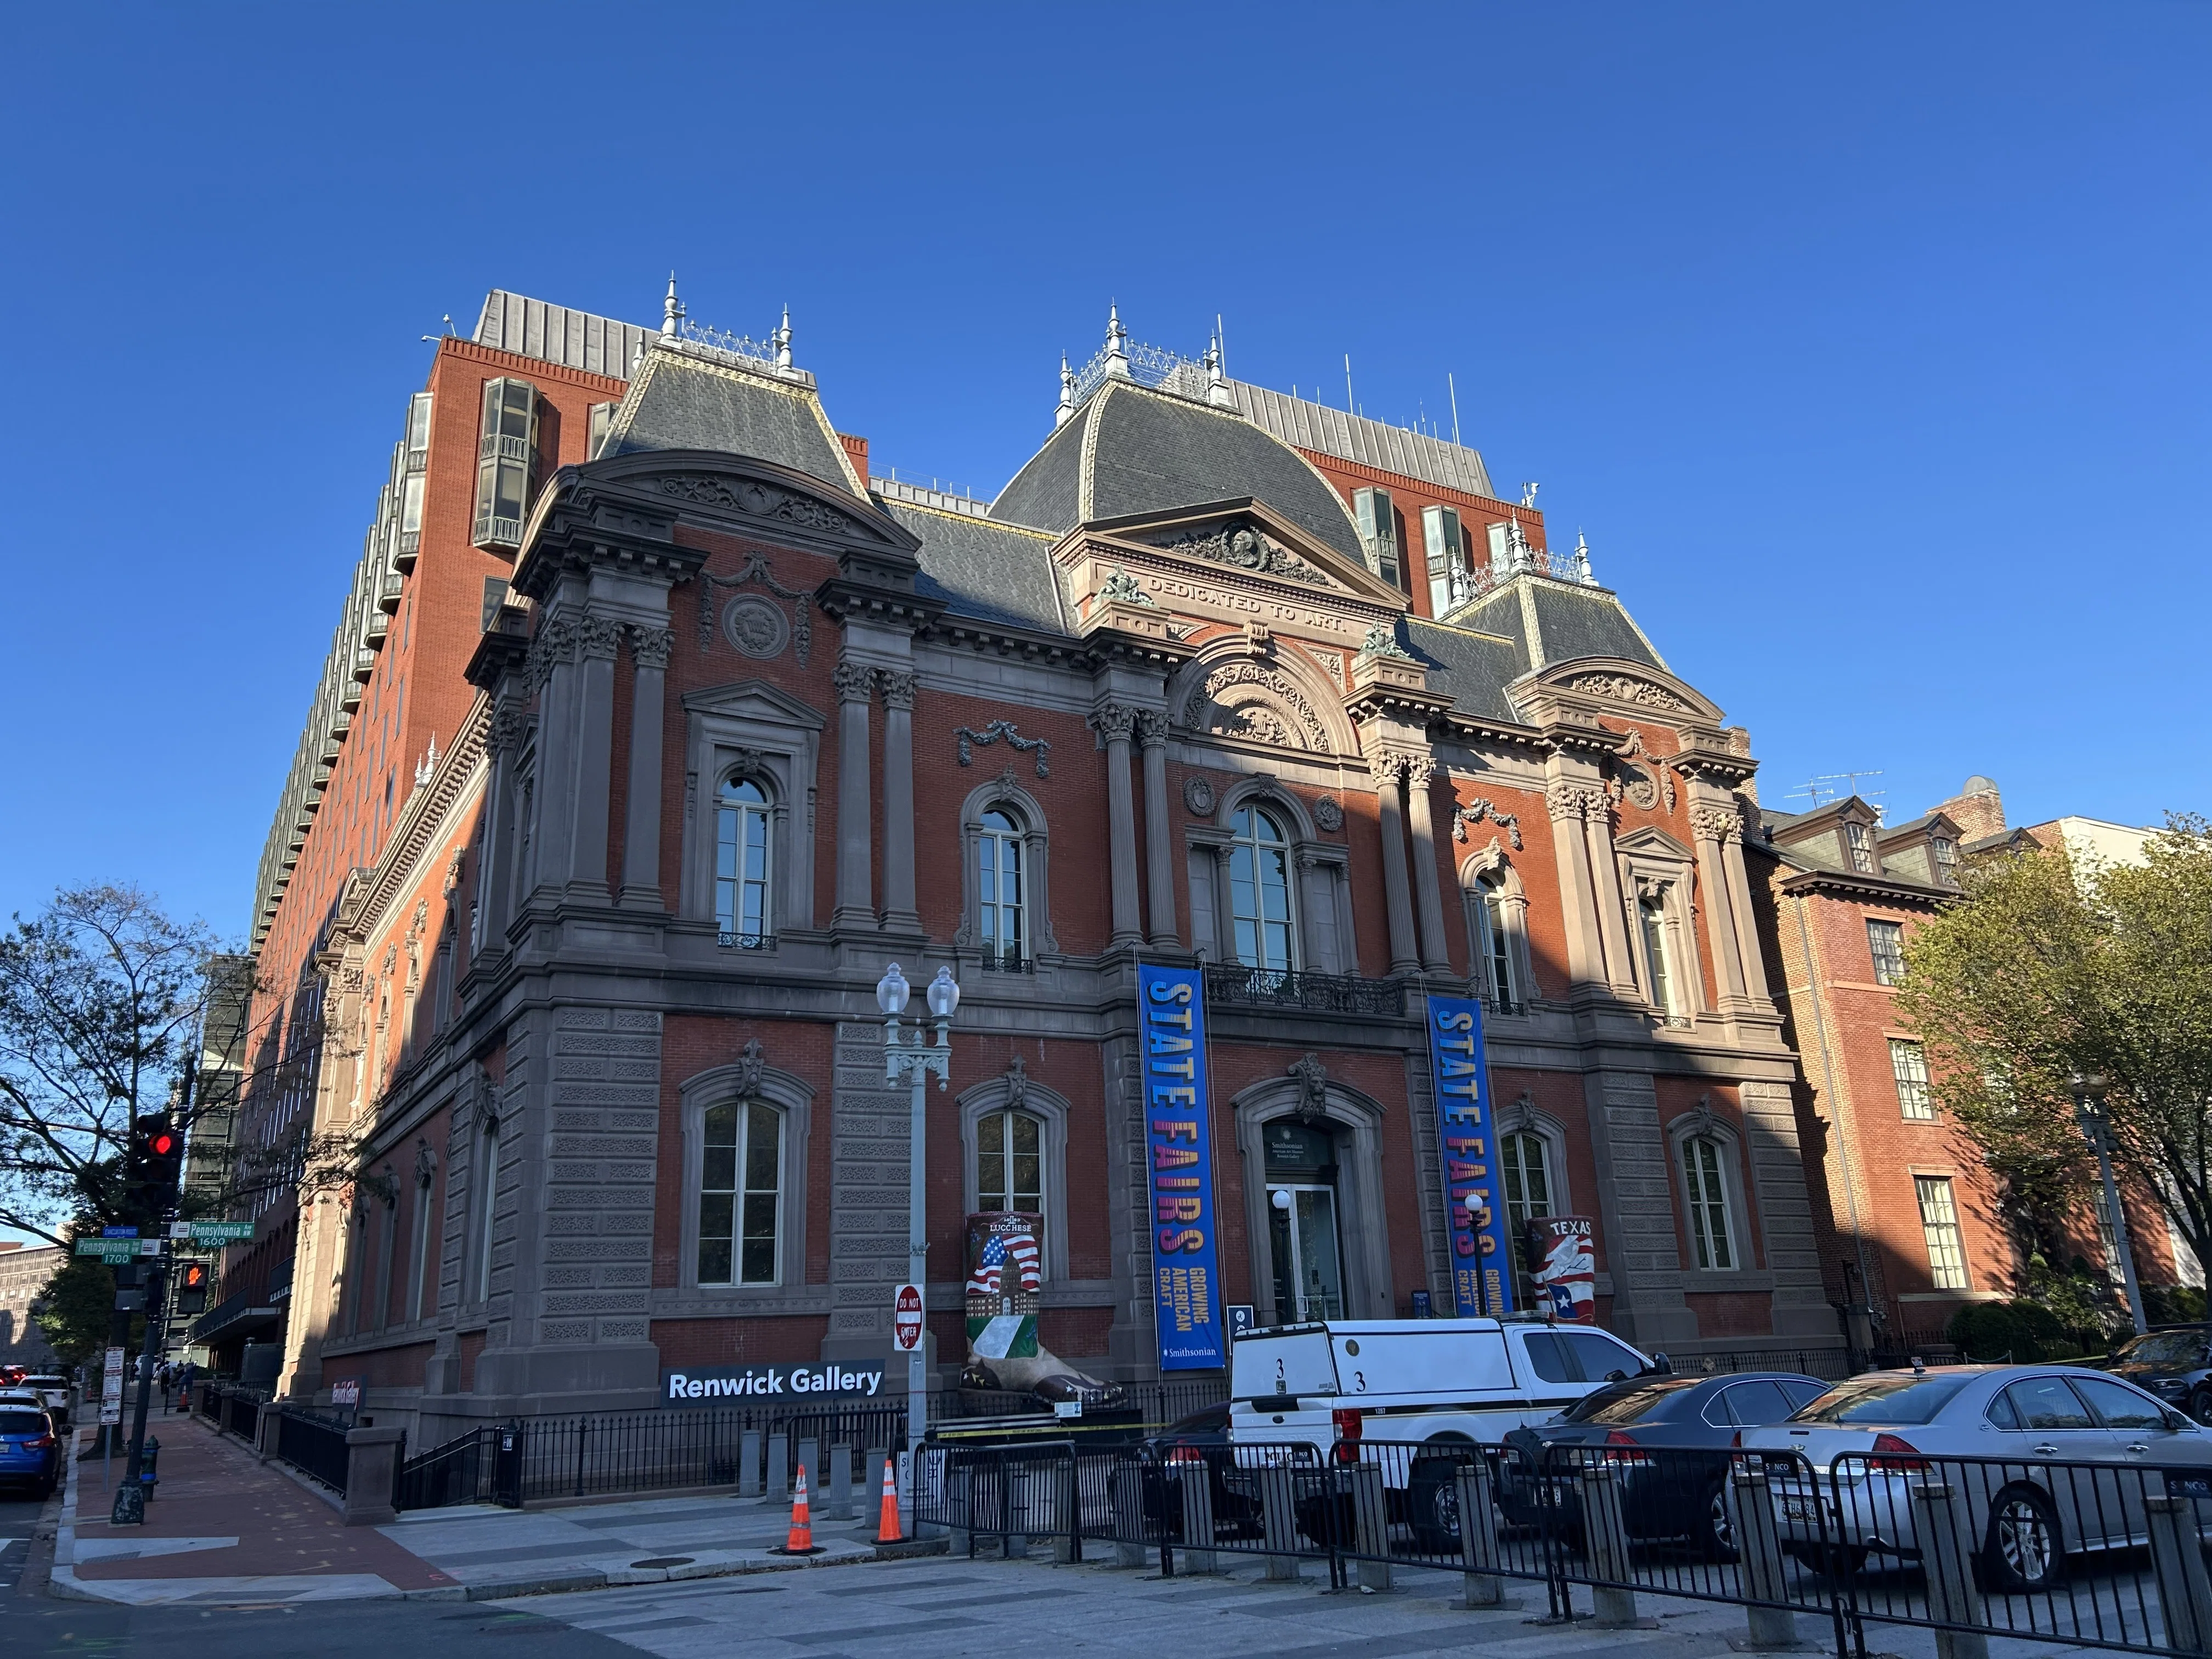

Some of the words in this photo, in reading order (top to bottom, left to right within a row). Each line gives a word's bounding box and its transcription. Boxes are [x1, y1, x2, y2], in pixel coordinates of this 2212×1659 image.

[1148, 576, 1261, 613] DEDICATED
[1269, 603, 1296, 620] TO
[1304, 611, 1346, 633] ART.
[1149, 980, 1197, 1107] STATE
[1437, 1010, 1482, 1124] STATE
[1272, 1141, 1303, 1149] Smithsonian
[1154, 1119, 1204, 1254] FAIRS
[191, 1224, 241, 1238] Pennsylvania
[990, 1224, 1032, 1233] LUCCHESE
[1550, 1220, 1592, 1236] TEXAS
[78, 1240, 129, 1255] Pennsylvania
[199, 1238, 225, 1246] 1600
[105, 1255, 129, 1263] 1700
[1160, 1267, 1172, 1308] CRAFT
[1189, 1267, 1210, 1324] GROWING
[1458, 1270, 1472, 1306] CRAFT
[1485, 1269, 1504, 1316] GROWIN
[900, 1298, 907, 1308] DO
[909, 1297, 919, 1308] NOT
[1172, 1267, 1192, 1331] AMERICAN
[901, 1327, 917, 1338] ENTER
[1169, 1347, 1216, 1358] Smithsonian
[1276, 1358, 1284, 1379] 3
[669, 1369, 784, 1398] Renwick
[790, 1365, 882, 1396] Gallery
[1354, 1371, 1366, 1392] 3
[1765, 1463, 1789, 1471] SNCO
